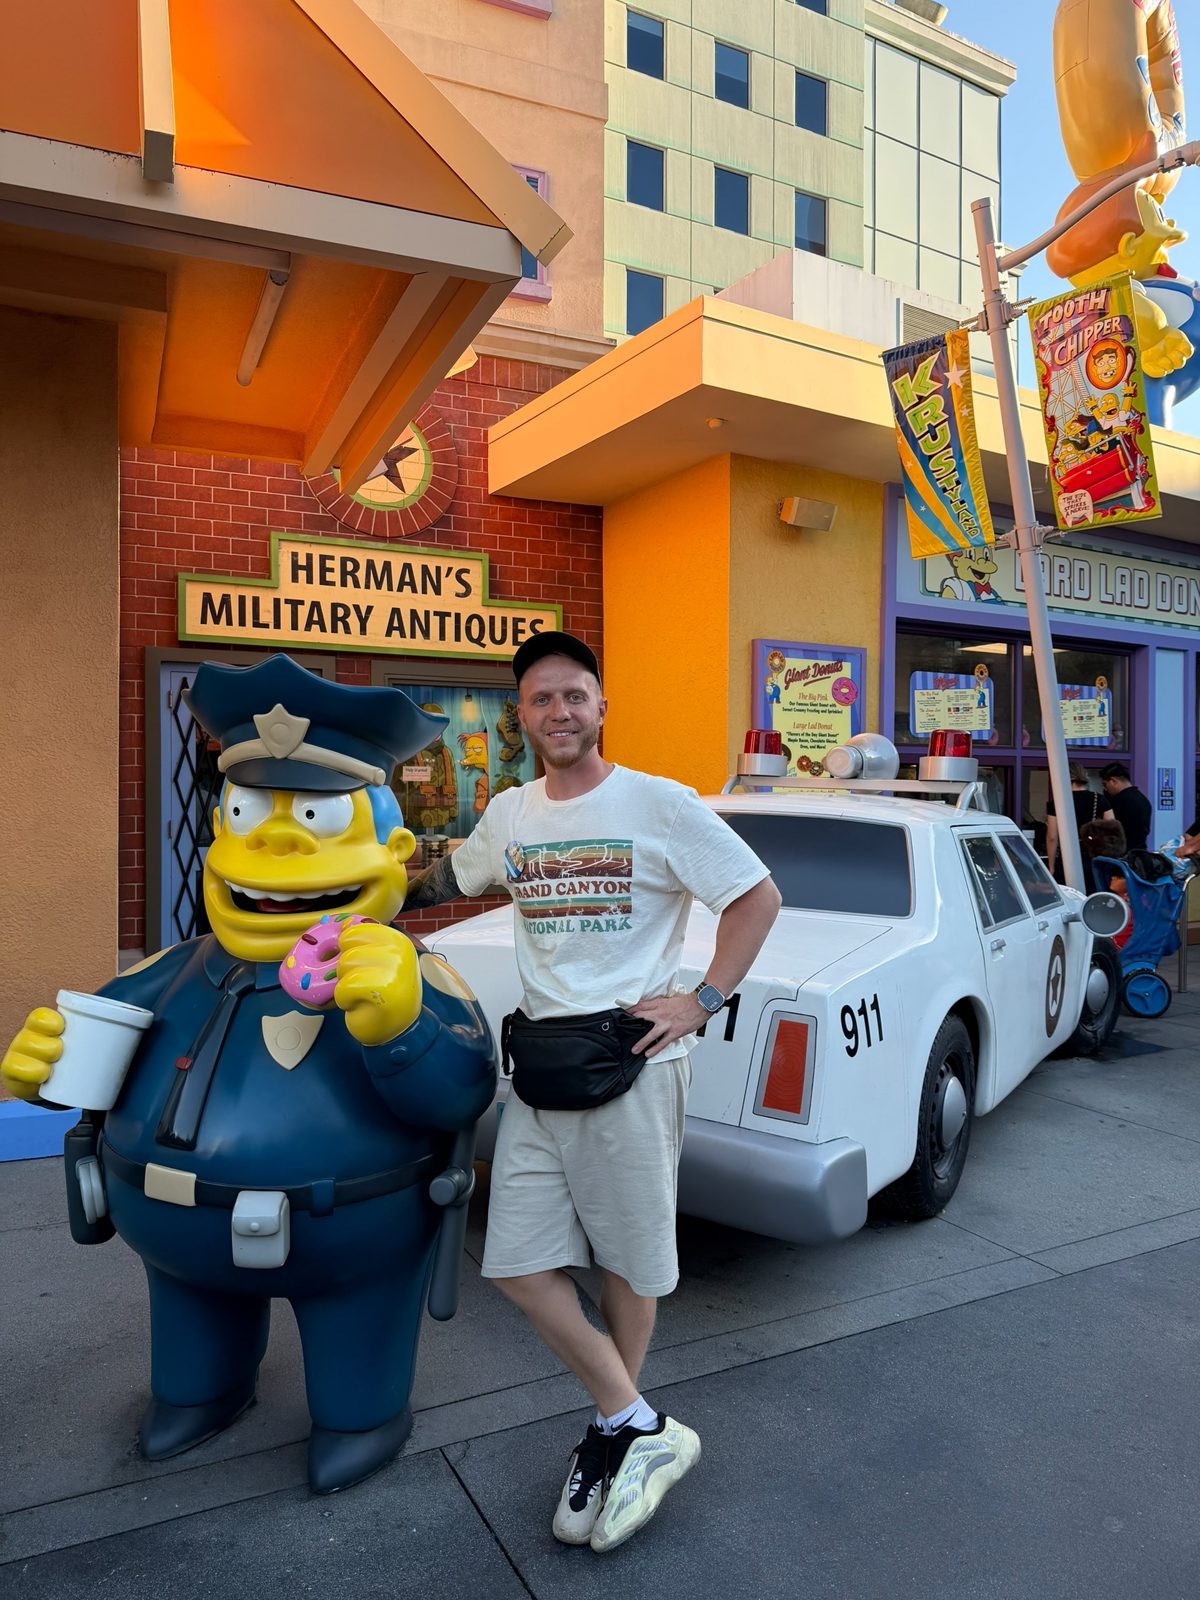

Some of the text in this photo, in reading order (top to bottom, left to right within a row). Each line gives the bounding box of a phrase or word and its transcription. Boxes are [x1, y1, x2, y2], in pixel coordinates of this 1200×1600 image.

[1040, 288, 1110, 330] TOOTH
[1053, 316, 1123, 366] CHIPPER
[892, 351, 981, 538] KRUSTYLAND
[290, 551, 472, 598] HERMAN'S
[1099, 563, 1150, 609] LAD
[200, 592, 374, 636] MILITARY
[784, 658, 843, 690] Giant Donuts
[515, 880, 631, 898] RAND CANYON
[580, 916, 632, 932] PARK
[840, 993, 884, 1058] 911
